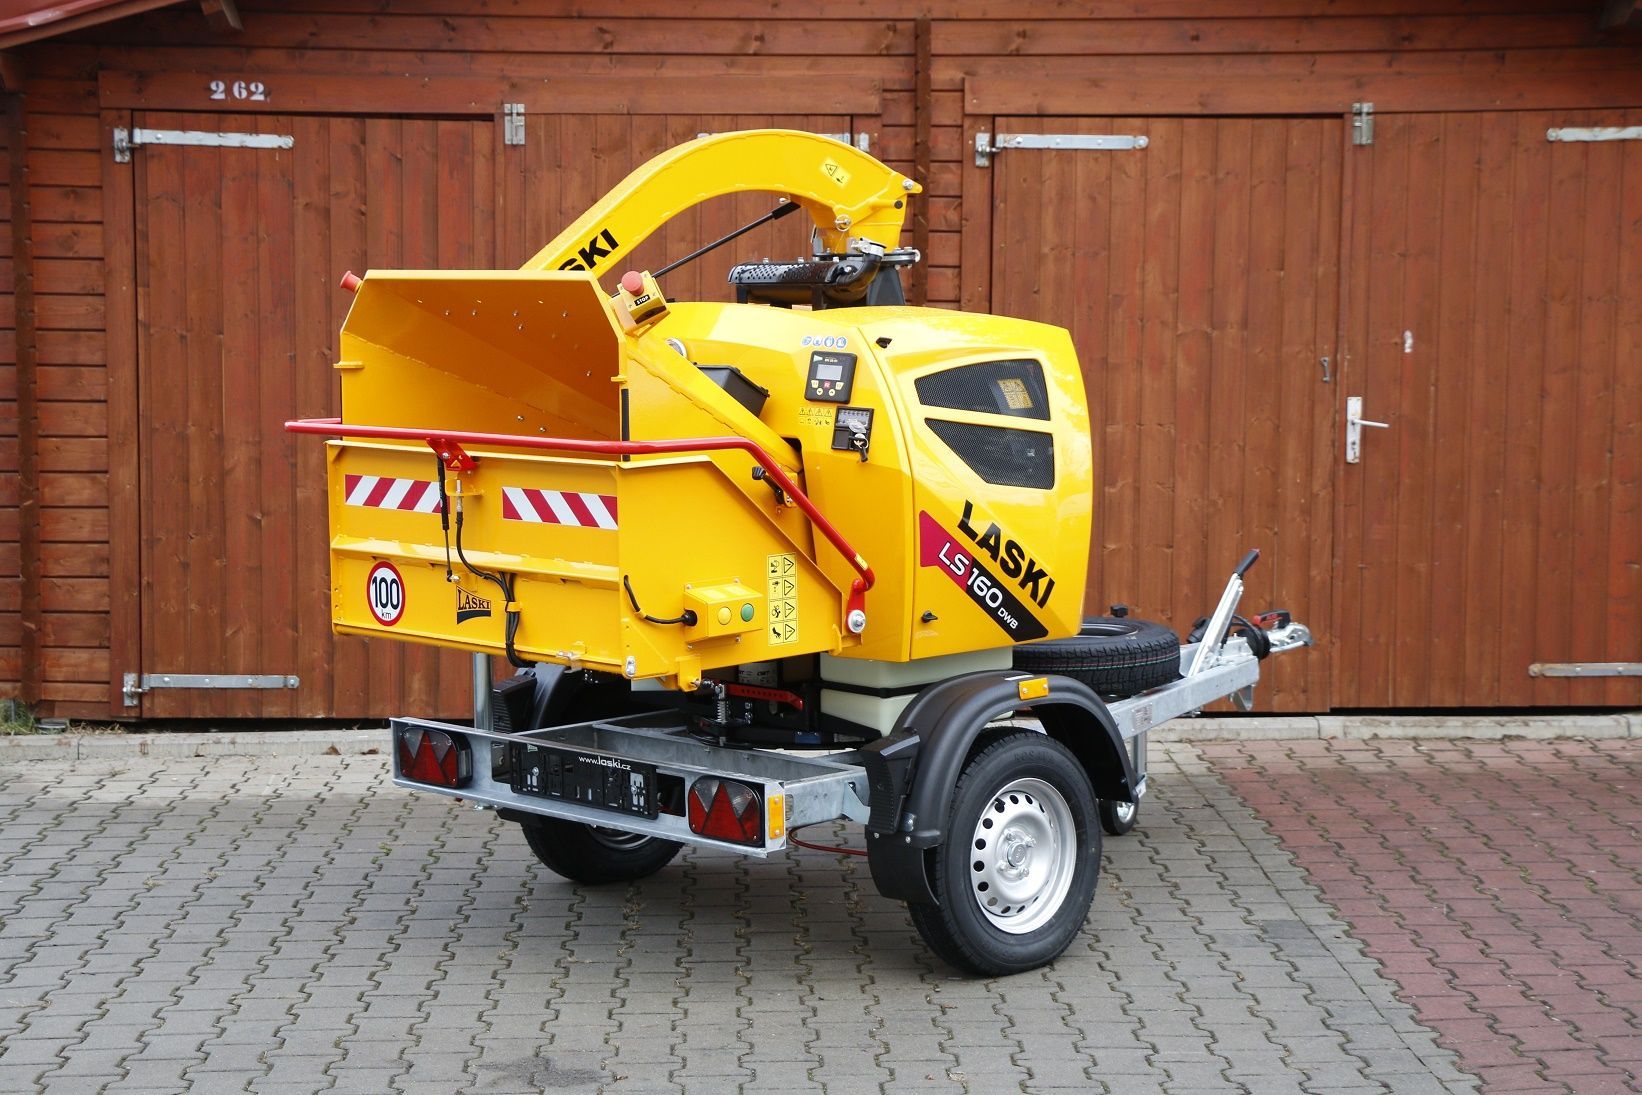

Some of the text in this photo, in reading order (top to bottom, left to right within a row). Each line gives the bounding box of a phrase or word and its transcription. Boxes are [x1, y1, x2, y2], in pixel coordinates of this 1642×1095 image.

[210, 80, 265, 101] 262
[636, 295, 649, 305] STOP
[957, 499, 1055, 609] LASKI
[372, 576, 400, 610] 100
[938, 542, 1018, 629] LS 160 DWB
[457, 589, 490, 610] LASKI
[381, 609, 392, 619] km
[578, 755, 632, 771] www.laski.cz
